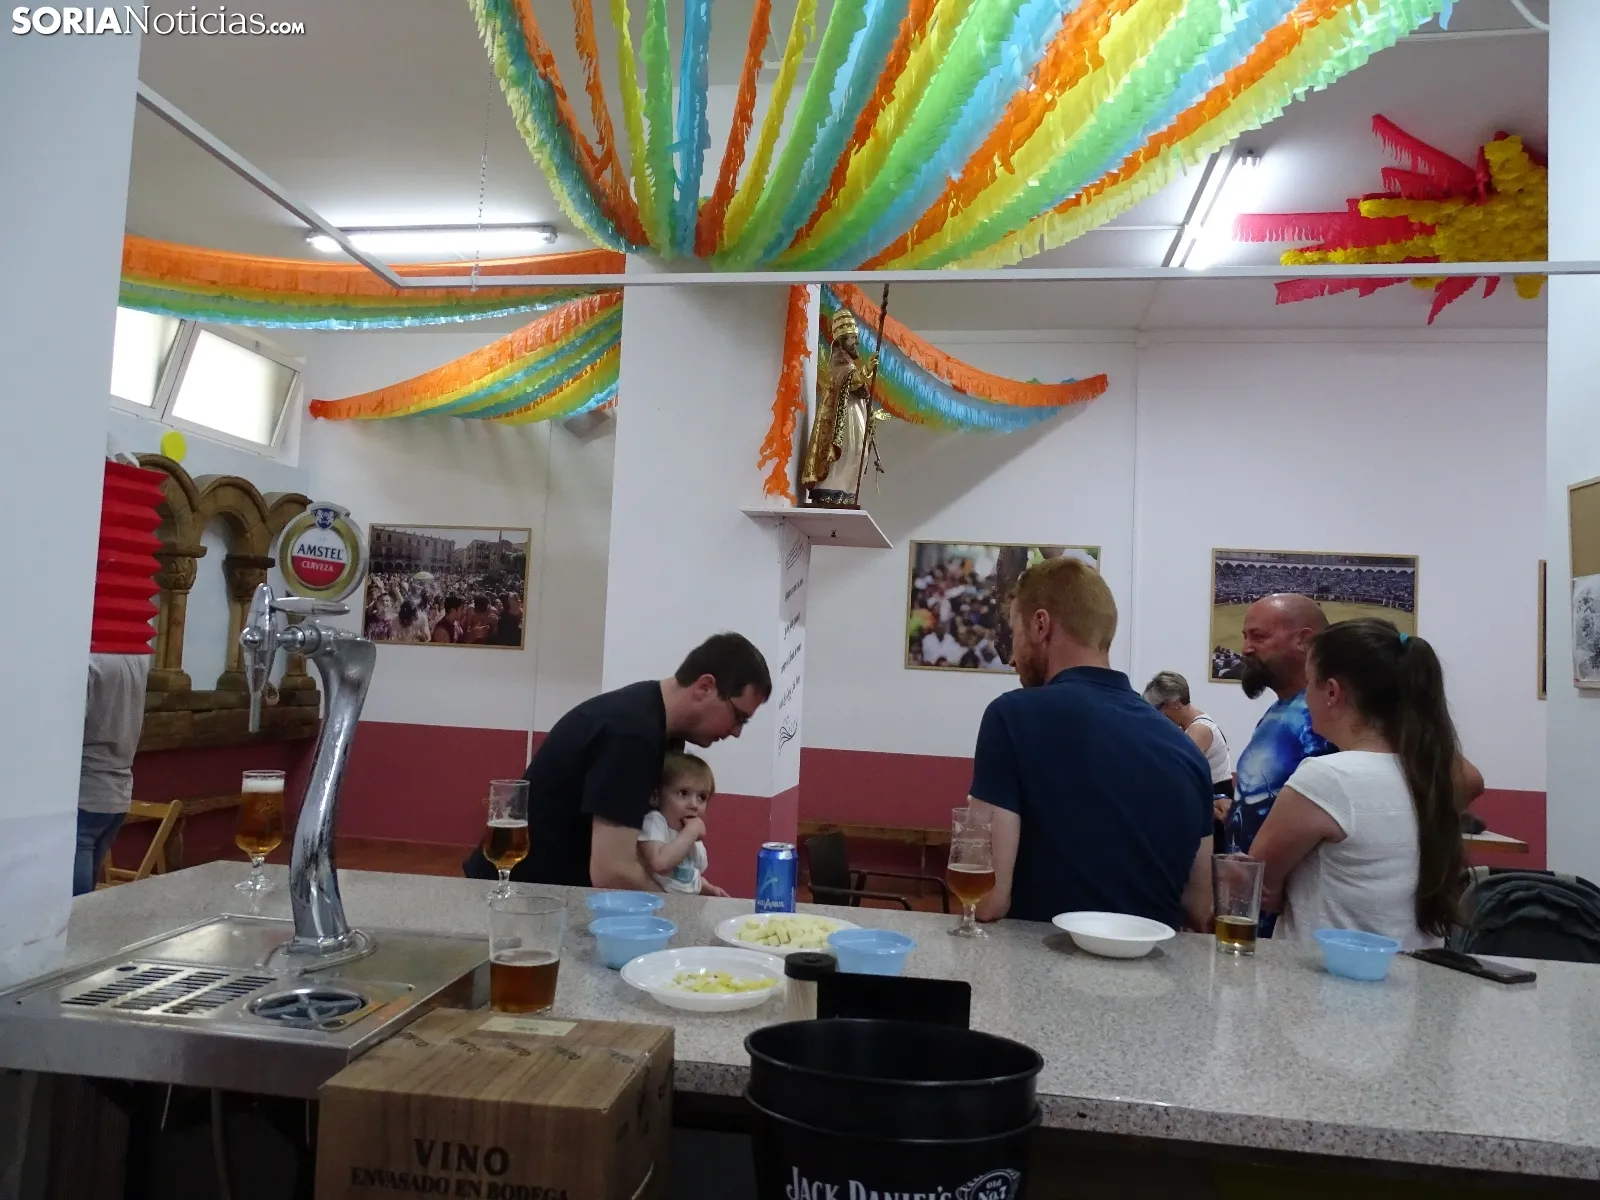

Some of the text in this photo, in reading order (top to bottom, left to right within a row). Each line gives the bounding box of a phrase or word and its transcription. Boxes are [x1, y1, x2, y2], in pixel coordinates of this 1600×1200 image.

[297, 543, 343, 560] AMSTEL
[301, 560, 334, 572] CERVEZA
[414, 1138, 510, 1177] VINO
[351, 1167, 451, 1195] ENVASADO
[453, 1179, 484, 1200] EN
[786, 1166, 840, 1200] JACK
